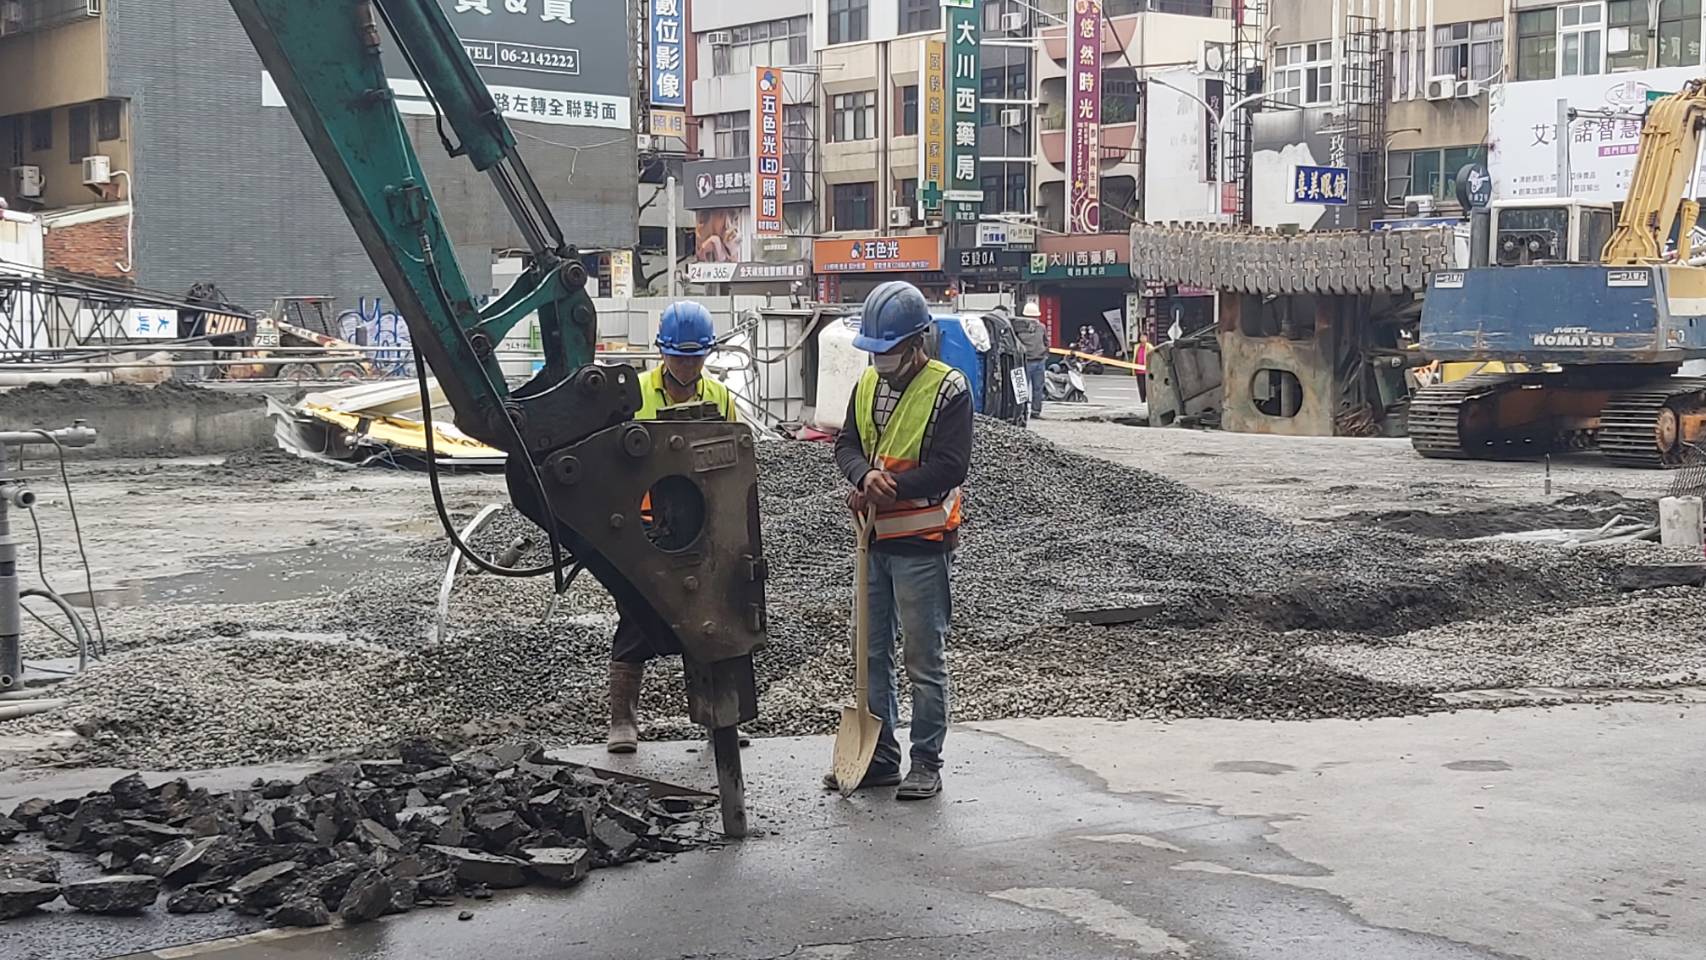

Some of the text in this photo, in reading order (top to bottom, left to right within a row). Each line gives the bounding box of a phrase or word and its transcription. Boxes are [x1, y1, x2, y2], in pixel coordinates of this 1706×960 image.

[464, 46, 575, 68] TEL 06-2142222
[655, 0, 680, 98] 數位影像
[1079, 17, 1095, 119] 悠然時光
[494, 92, 617, 121] 路左轉全聯對面
[956, 20, 976, 181] 大川西藥房
[1296, 170, 1346, 200] 喜美眼鏡
[864, 241, 899, 259] 五色光
[1050, 249, 1116, 266] 大川西藥房
[257, 335, 278, 345] 753
[1533, 334, 1615, 346] KOMATSU
